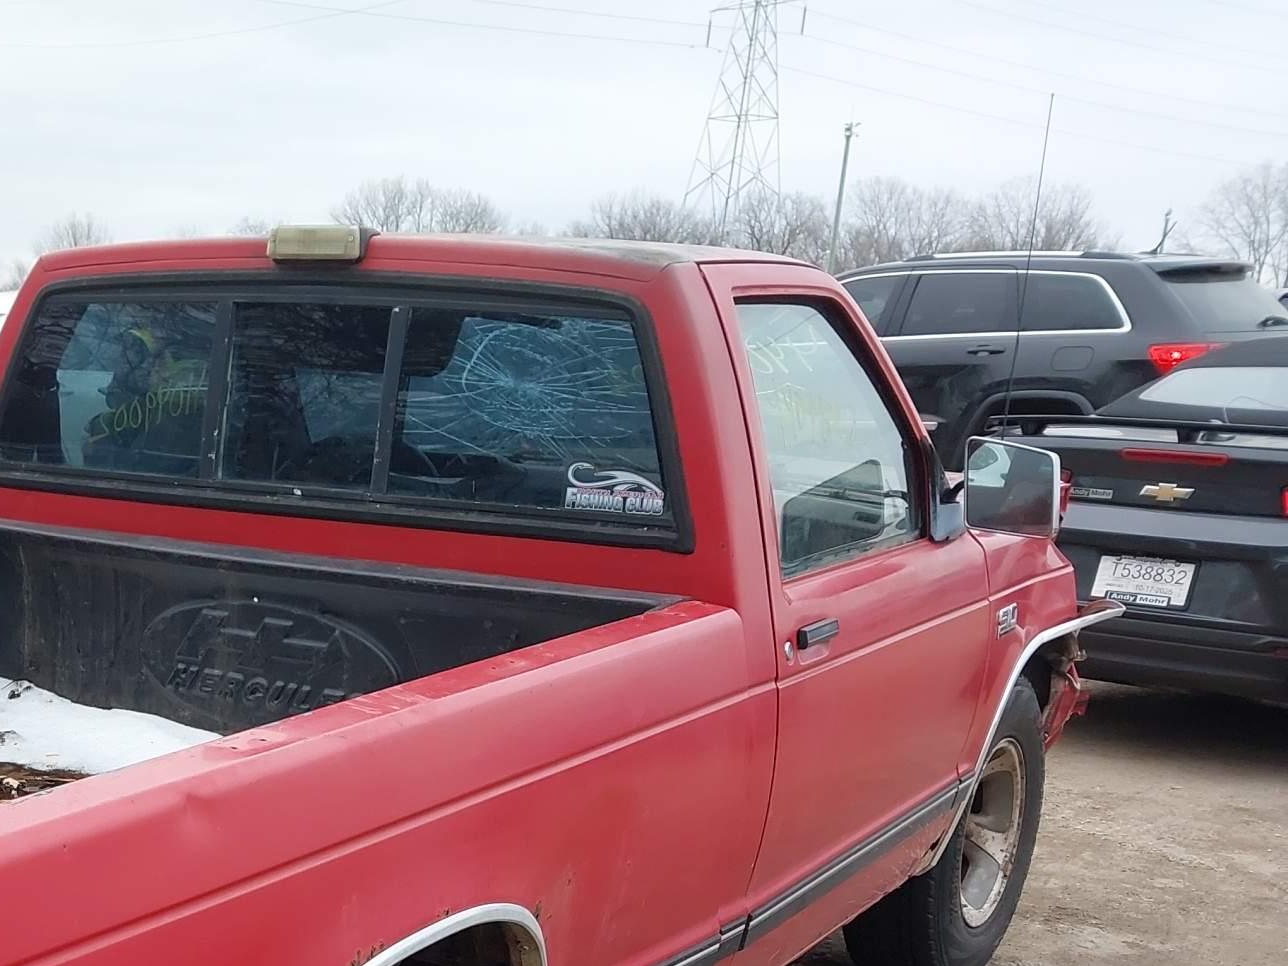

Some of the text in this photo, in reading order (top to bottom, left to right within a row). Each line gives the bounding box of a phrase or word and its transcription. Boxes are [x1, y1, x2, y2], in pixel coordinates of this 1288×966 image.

[564, 487, 664, 516] FISHING CLUB
[1111, 561, 1188, 586] T538832
[1110, 592, 1168, 607] Andy Mohr
